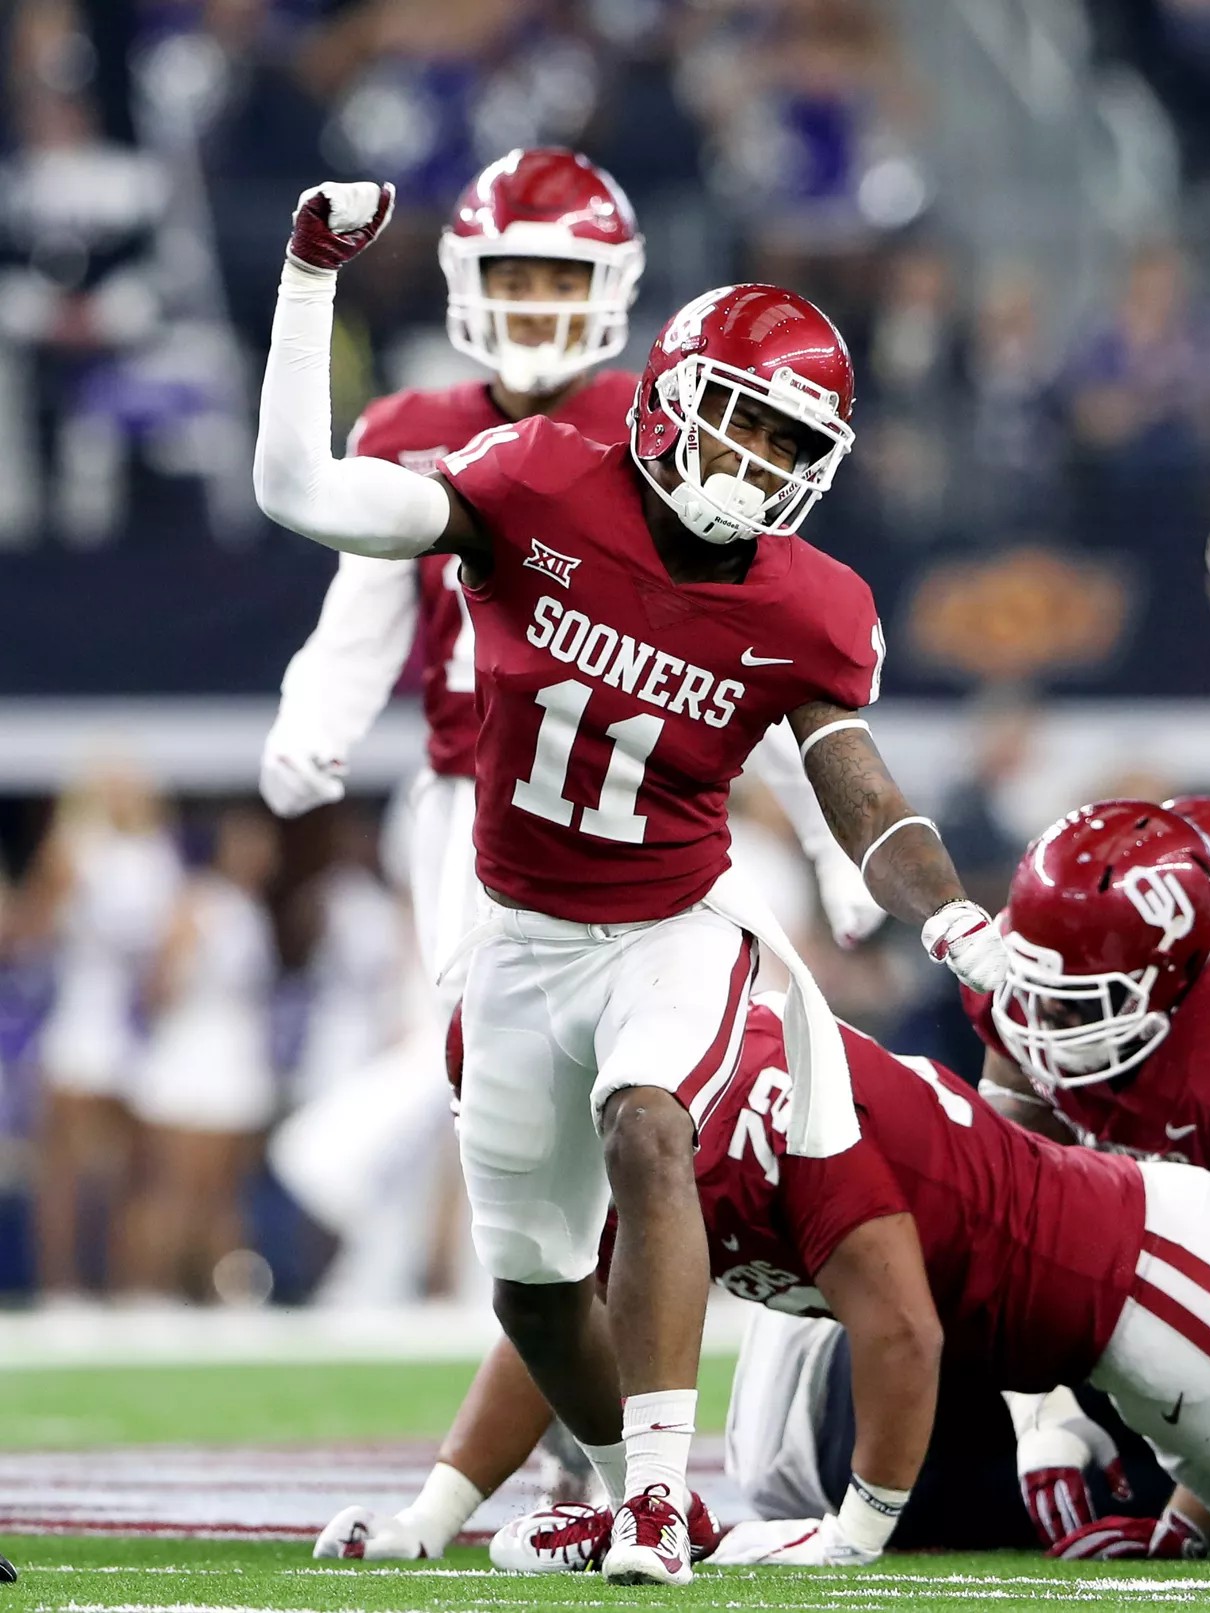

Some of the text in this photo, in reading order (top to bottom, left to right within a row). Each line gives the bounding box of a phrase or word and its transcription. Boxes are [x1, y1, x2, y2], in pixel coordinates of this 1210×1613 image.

[714, 516, 740, 530] Riddell
[526, 596, 745, 728] SOONERS
[511, 679, 665, 844] 11
